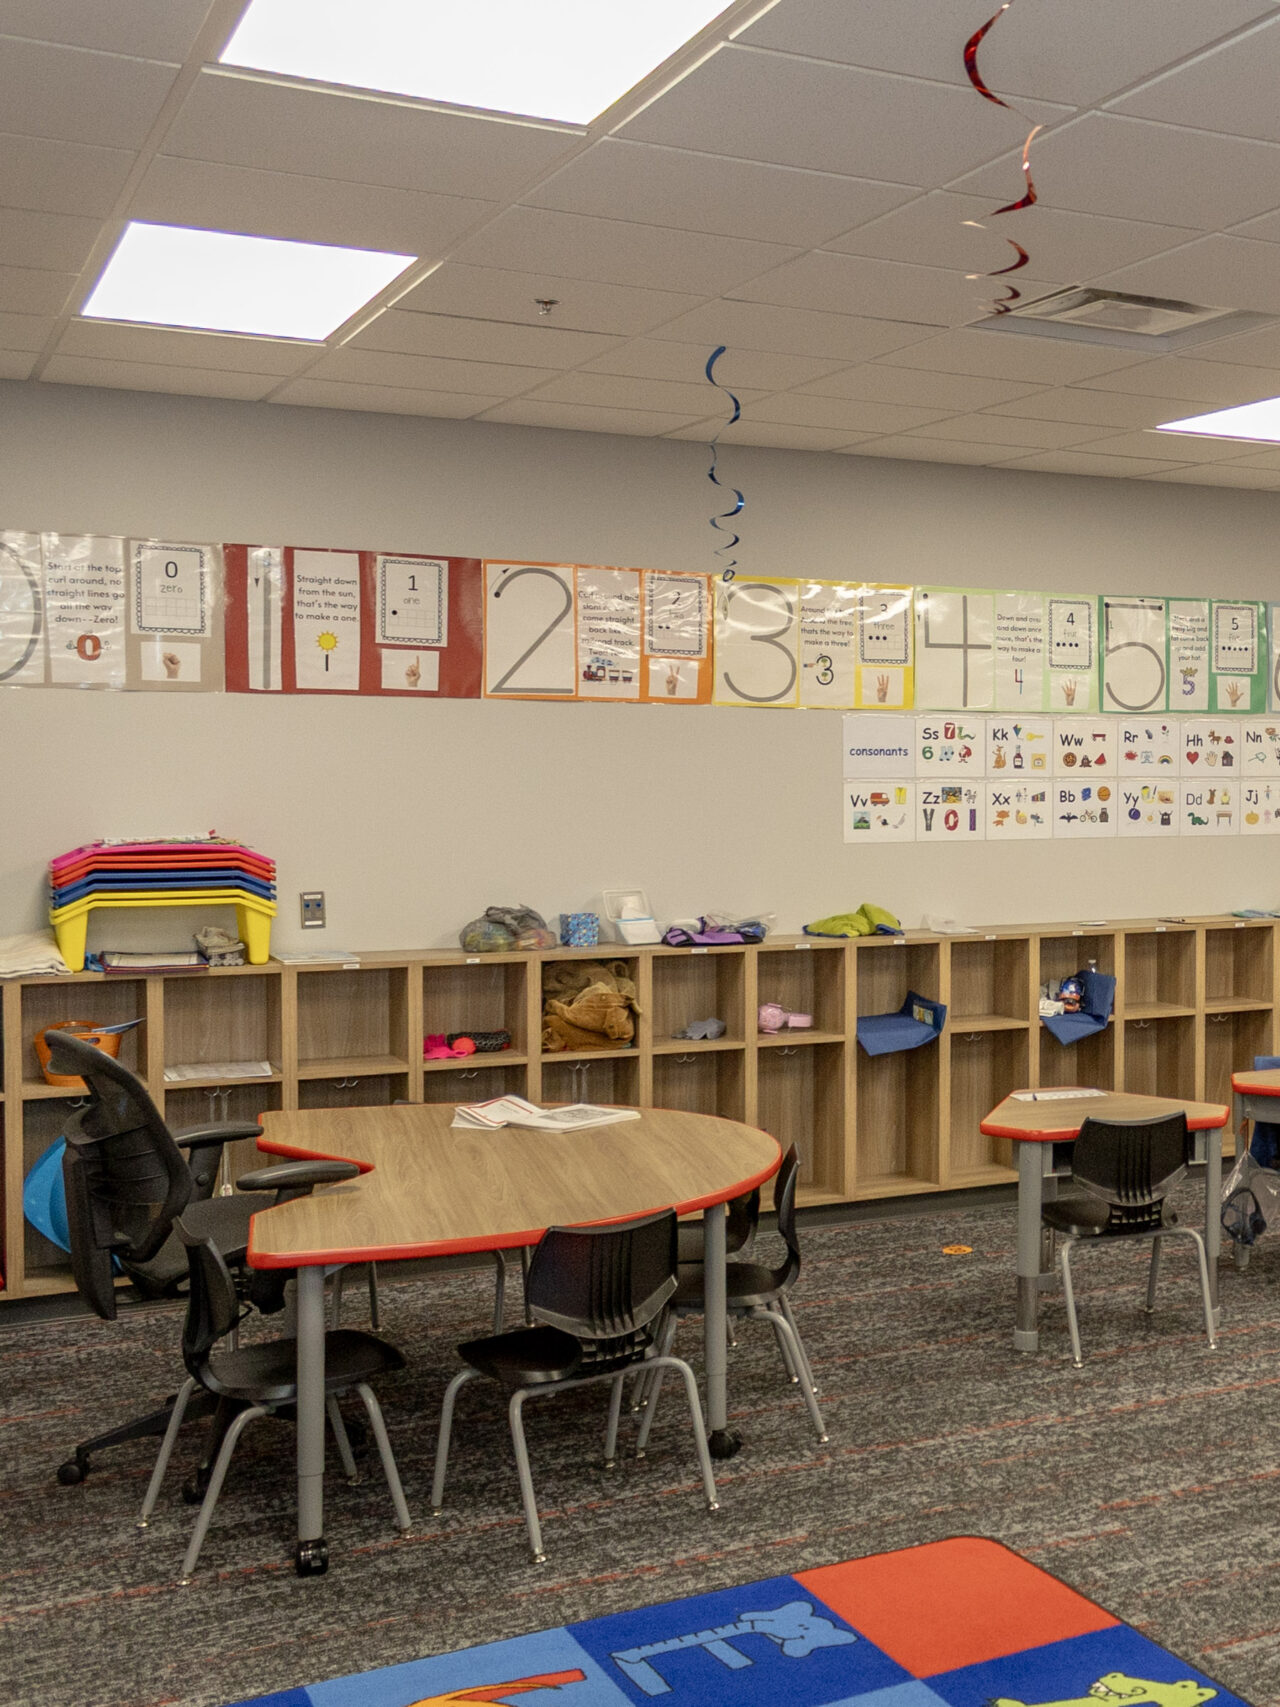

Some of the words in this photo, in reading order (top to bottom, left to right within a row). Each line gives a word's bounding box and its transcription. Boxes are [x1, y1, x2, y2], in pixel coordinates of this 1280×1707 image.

[87, 564, 103, 573] the
[165, 561, 178, 579] 0
[48, 575, 67, 585] curl
[110, 578, 122, 586] no
[296, 574, 333, 586] Straight
[335, 576, 358, 586] down
[407, 574, 419, 592] 1
[46, 588, 86, 600] straight
[87, 589, 110, 599] lines
[112, 591, 126, 600] go
[159, 584, 184, 594] zero
[298, 587, 321, 597] from
[322, 588, 337, 597] the
[338, 589, 356, 599] sun,
[296, 599, 322, 609] that's
[324, 600, 339, 609] the
[340, 603, 358, 612] way
[295, 612, 305, 621] to
[306, 612, 331, 621] make
[605, 614, 635, 625] straight
[1066, 612, 1075, 626] 4
[490, 567, 574, 693] 2
[1231, 617, 1239, 631] 5
[723, 583, 797, 703] 3
[924, 595, 992, 708] 4
[1105, 603, 1166, 711] 5
[816, 655, 834, 686] 3
[922, 727, 939, 740] Ss
[992, 728, 1009, 741] Kk
[1060, 733, 1084, 747] Ww
[1124, 730, 1139, 743] Rr
[1246, 731, 1262, 743] Nn
[1186, 734, 1203, 747] Hh
[850, 746, 908, 757] consonants
[922, 746, 934, 760] 6
[850, 794, 868, 807] Vv
[922, 791, 940, 805] Zz
[992, 793, 1011, 805] Xx
[1059, 790, 1076, 803] Bb
[1123, 792, 1139, 808] Yy
[1186, 793, 1203, 805] Dd
[1246, 789, 1259, 805] Jj
